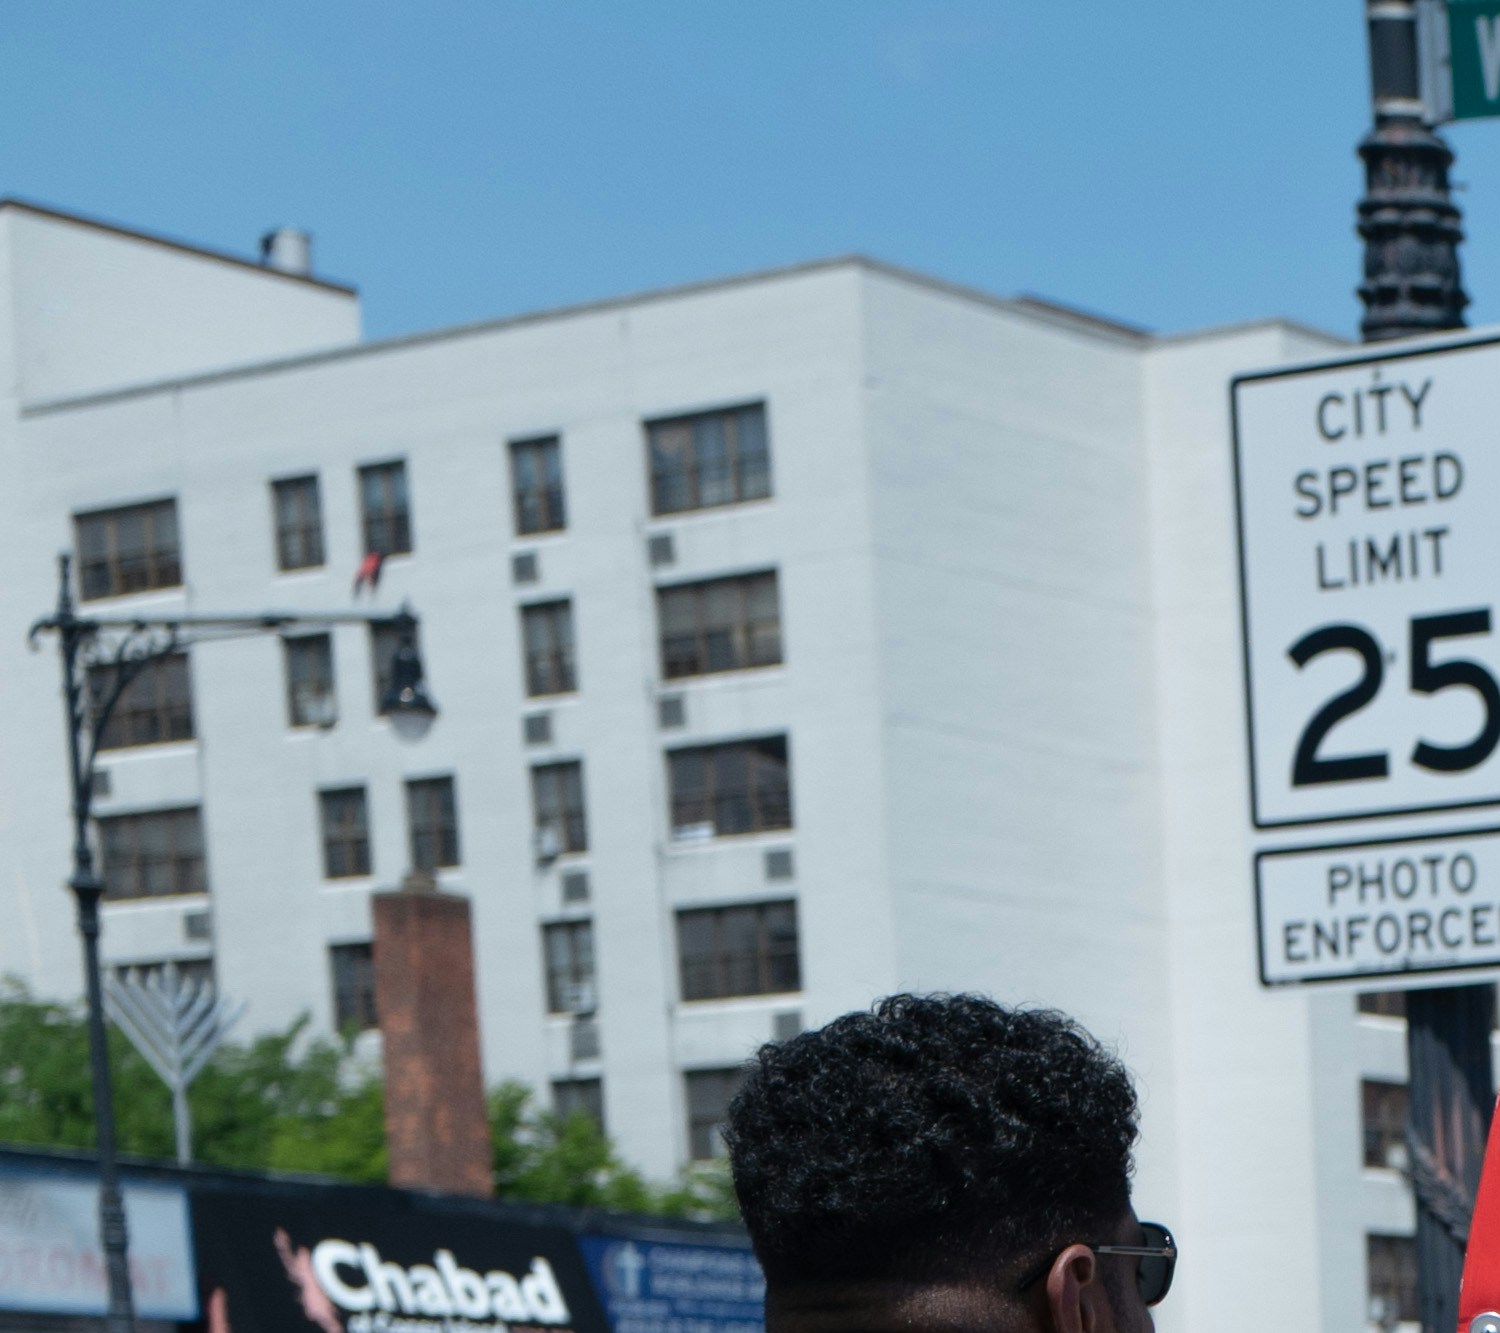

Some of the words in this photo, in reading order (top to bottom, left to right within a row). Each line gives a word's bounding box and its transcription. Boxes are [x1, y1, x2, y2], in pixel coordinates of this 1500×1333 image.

[1318, 379, 1432, 441] CITY
[1294, 452, 1464, 519] SPEED
[1316, 530, 1450, 590] LIMIT
[1328, 853, 1477, 906] PHOTO
[312, 1239, 571, 1324] Chabad
